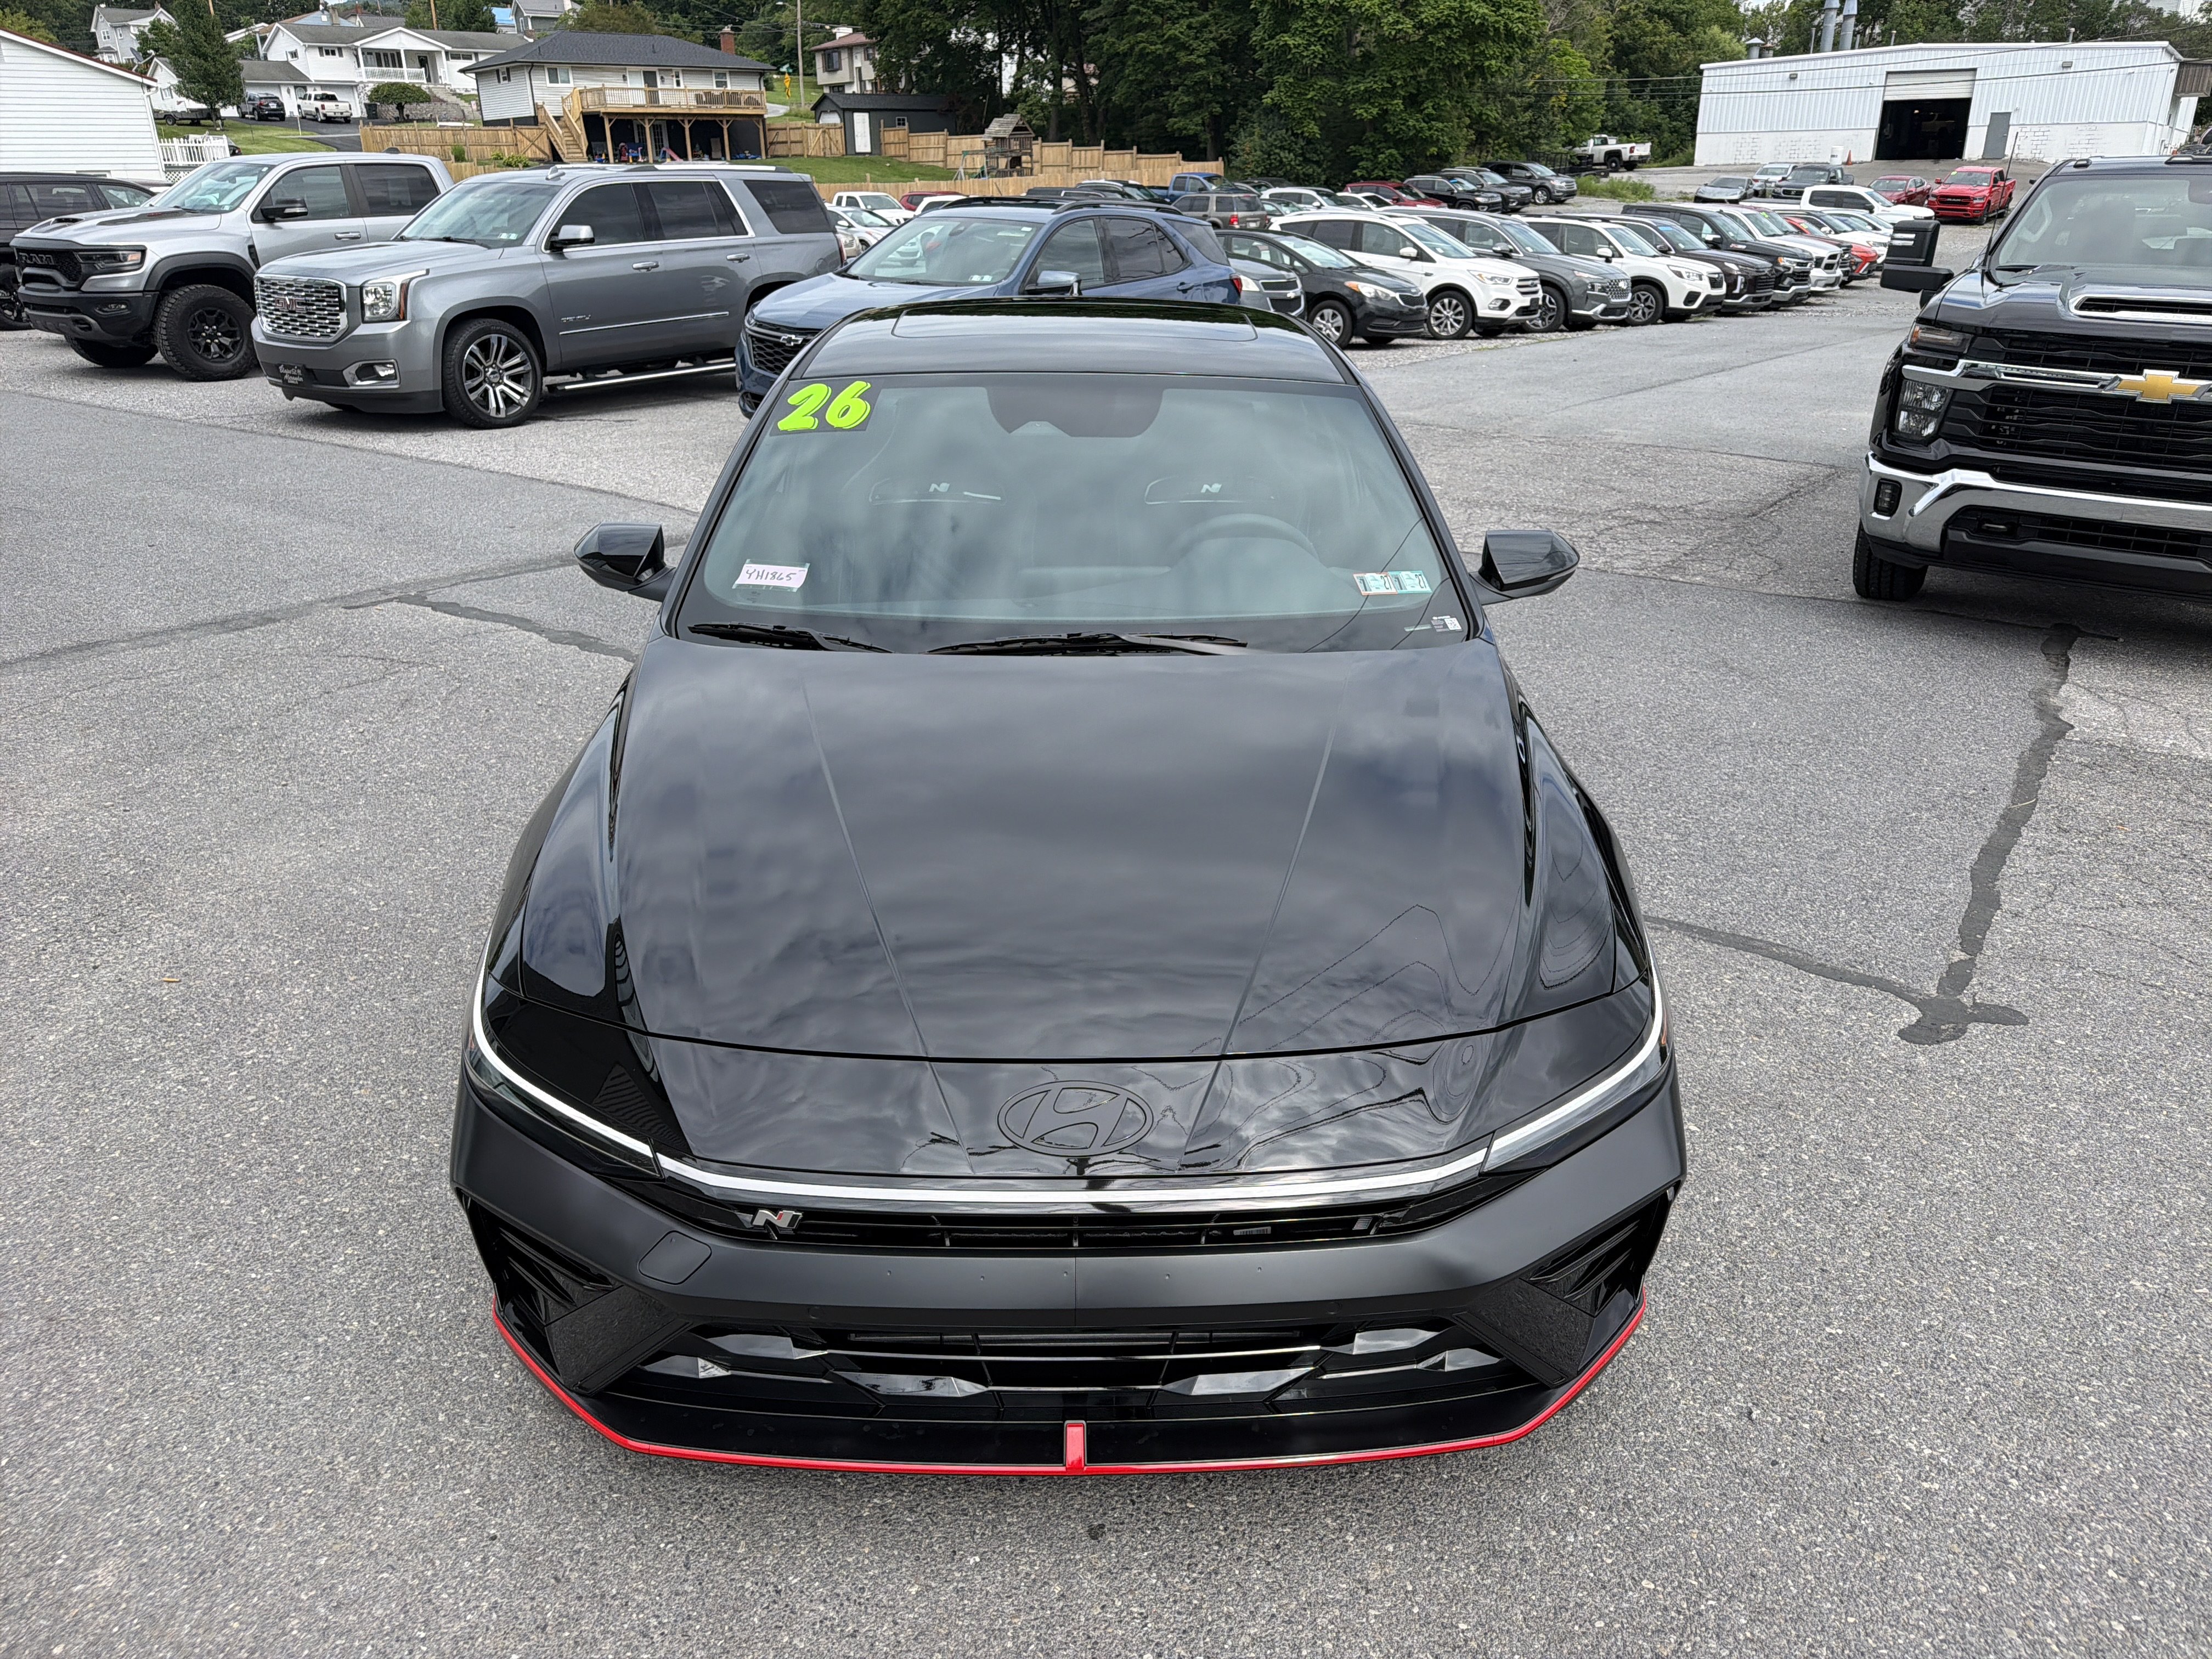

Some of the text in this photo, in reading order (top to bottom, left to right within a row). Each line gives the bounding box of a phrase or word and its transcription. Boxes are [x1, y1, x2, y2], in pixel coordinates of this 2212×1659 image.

[19, 252, 55, 265] RAM
[275, 296, 307, 311] GMC
[777, 380, 871, 431] 26
[929, 482, 950, 492] N
[1200, 483, 1222, 493] N
[752, 1209, 803, 1229] N
